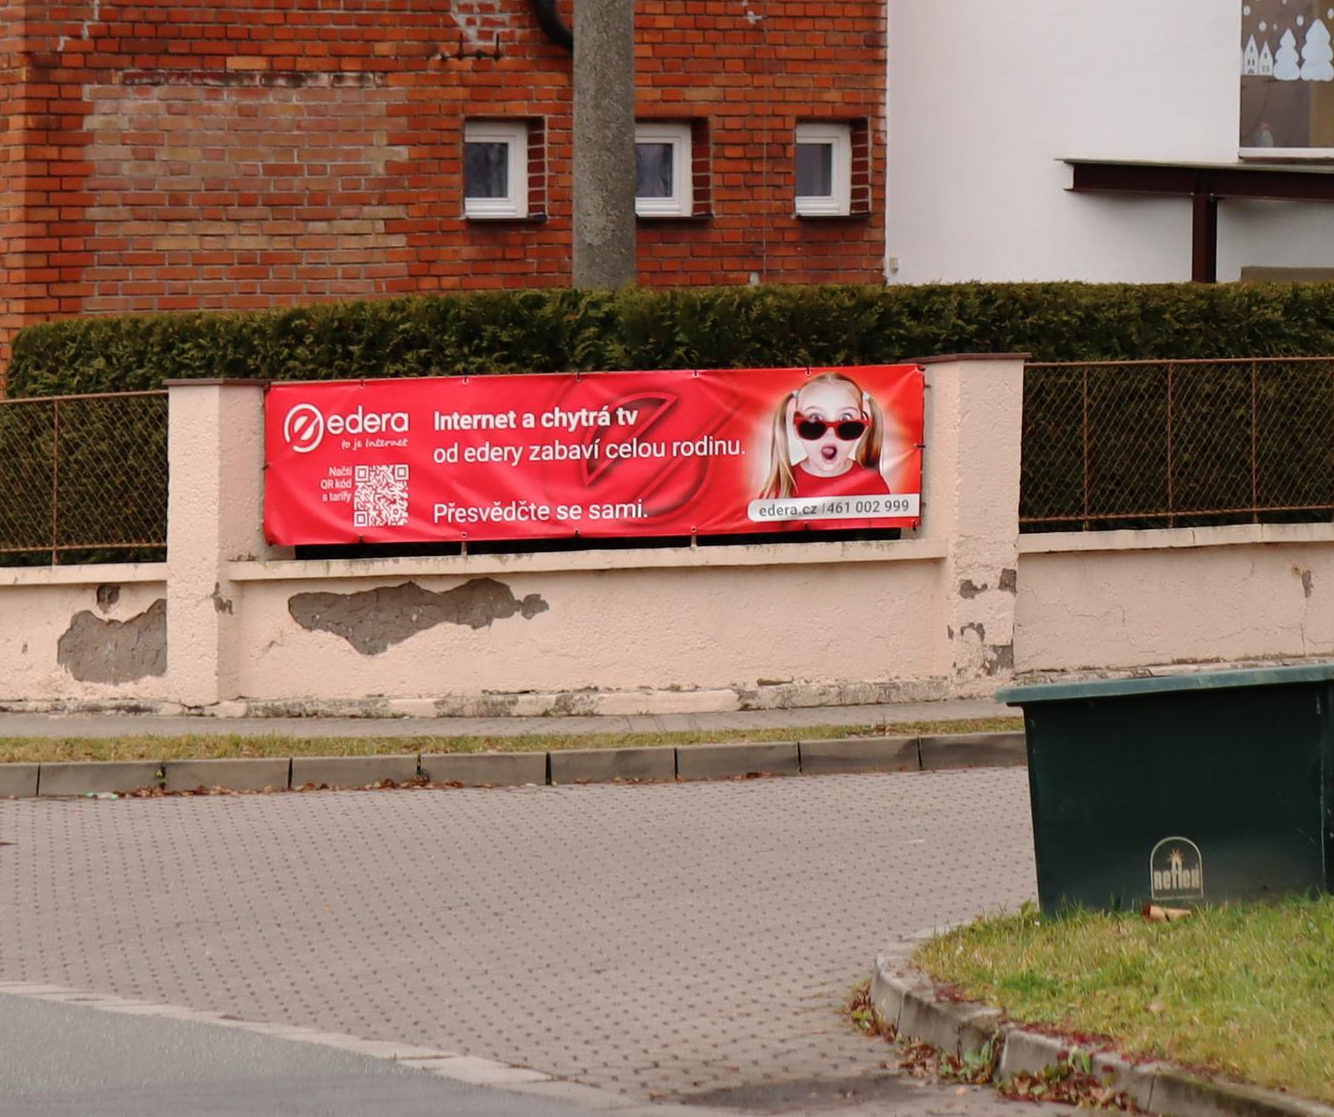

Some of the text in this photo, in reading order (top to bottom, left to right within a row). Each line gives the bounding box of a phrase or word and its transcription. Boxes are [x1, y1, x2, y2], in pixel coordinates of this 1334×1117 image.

[327, 405, 408, 434] edera
[434, 406, 639, 432] Internet a chytrá tv
[341, 439, 351, 449] to
[353, 438, 362, 451] je
[433, 435, 746, 467] od edery zabaví celou rodinu.
[329, 467, 352, 476] Načti
[321, 479, 352, 490] QR kód
[329, 491, 352, 502] tarify
[433, 499, 648, 524] Přesvědčte se sami.
[759, 499, 909, 517] edera.cz 461 002 999
